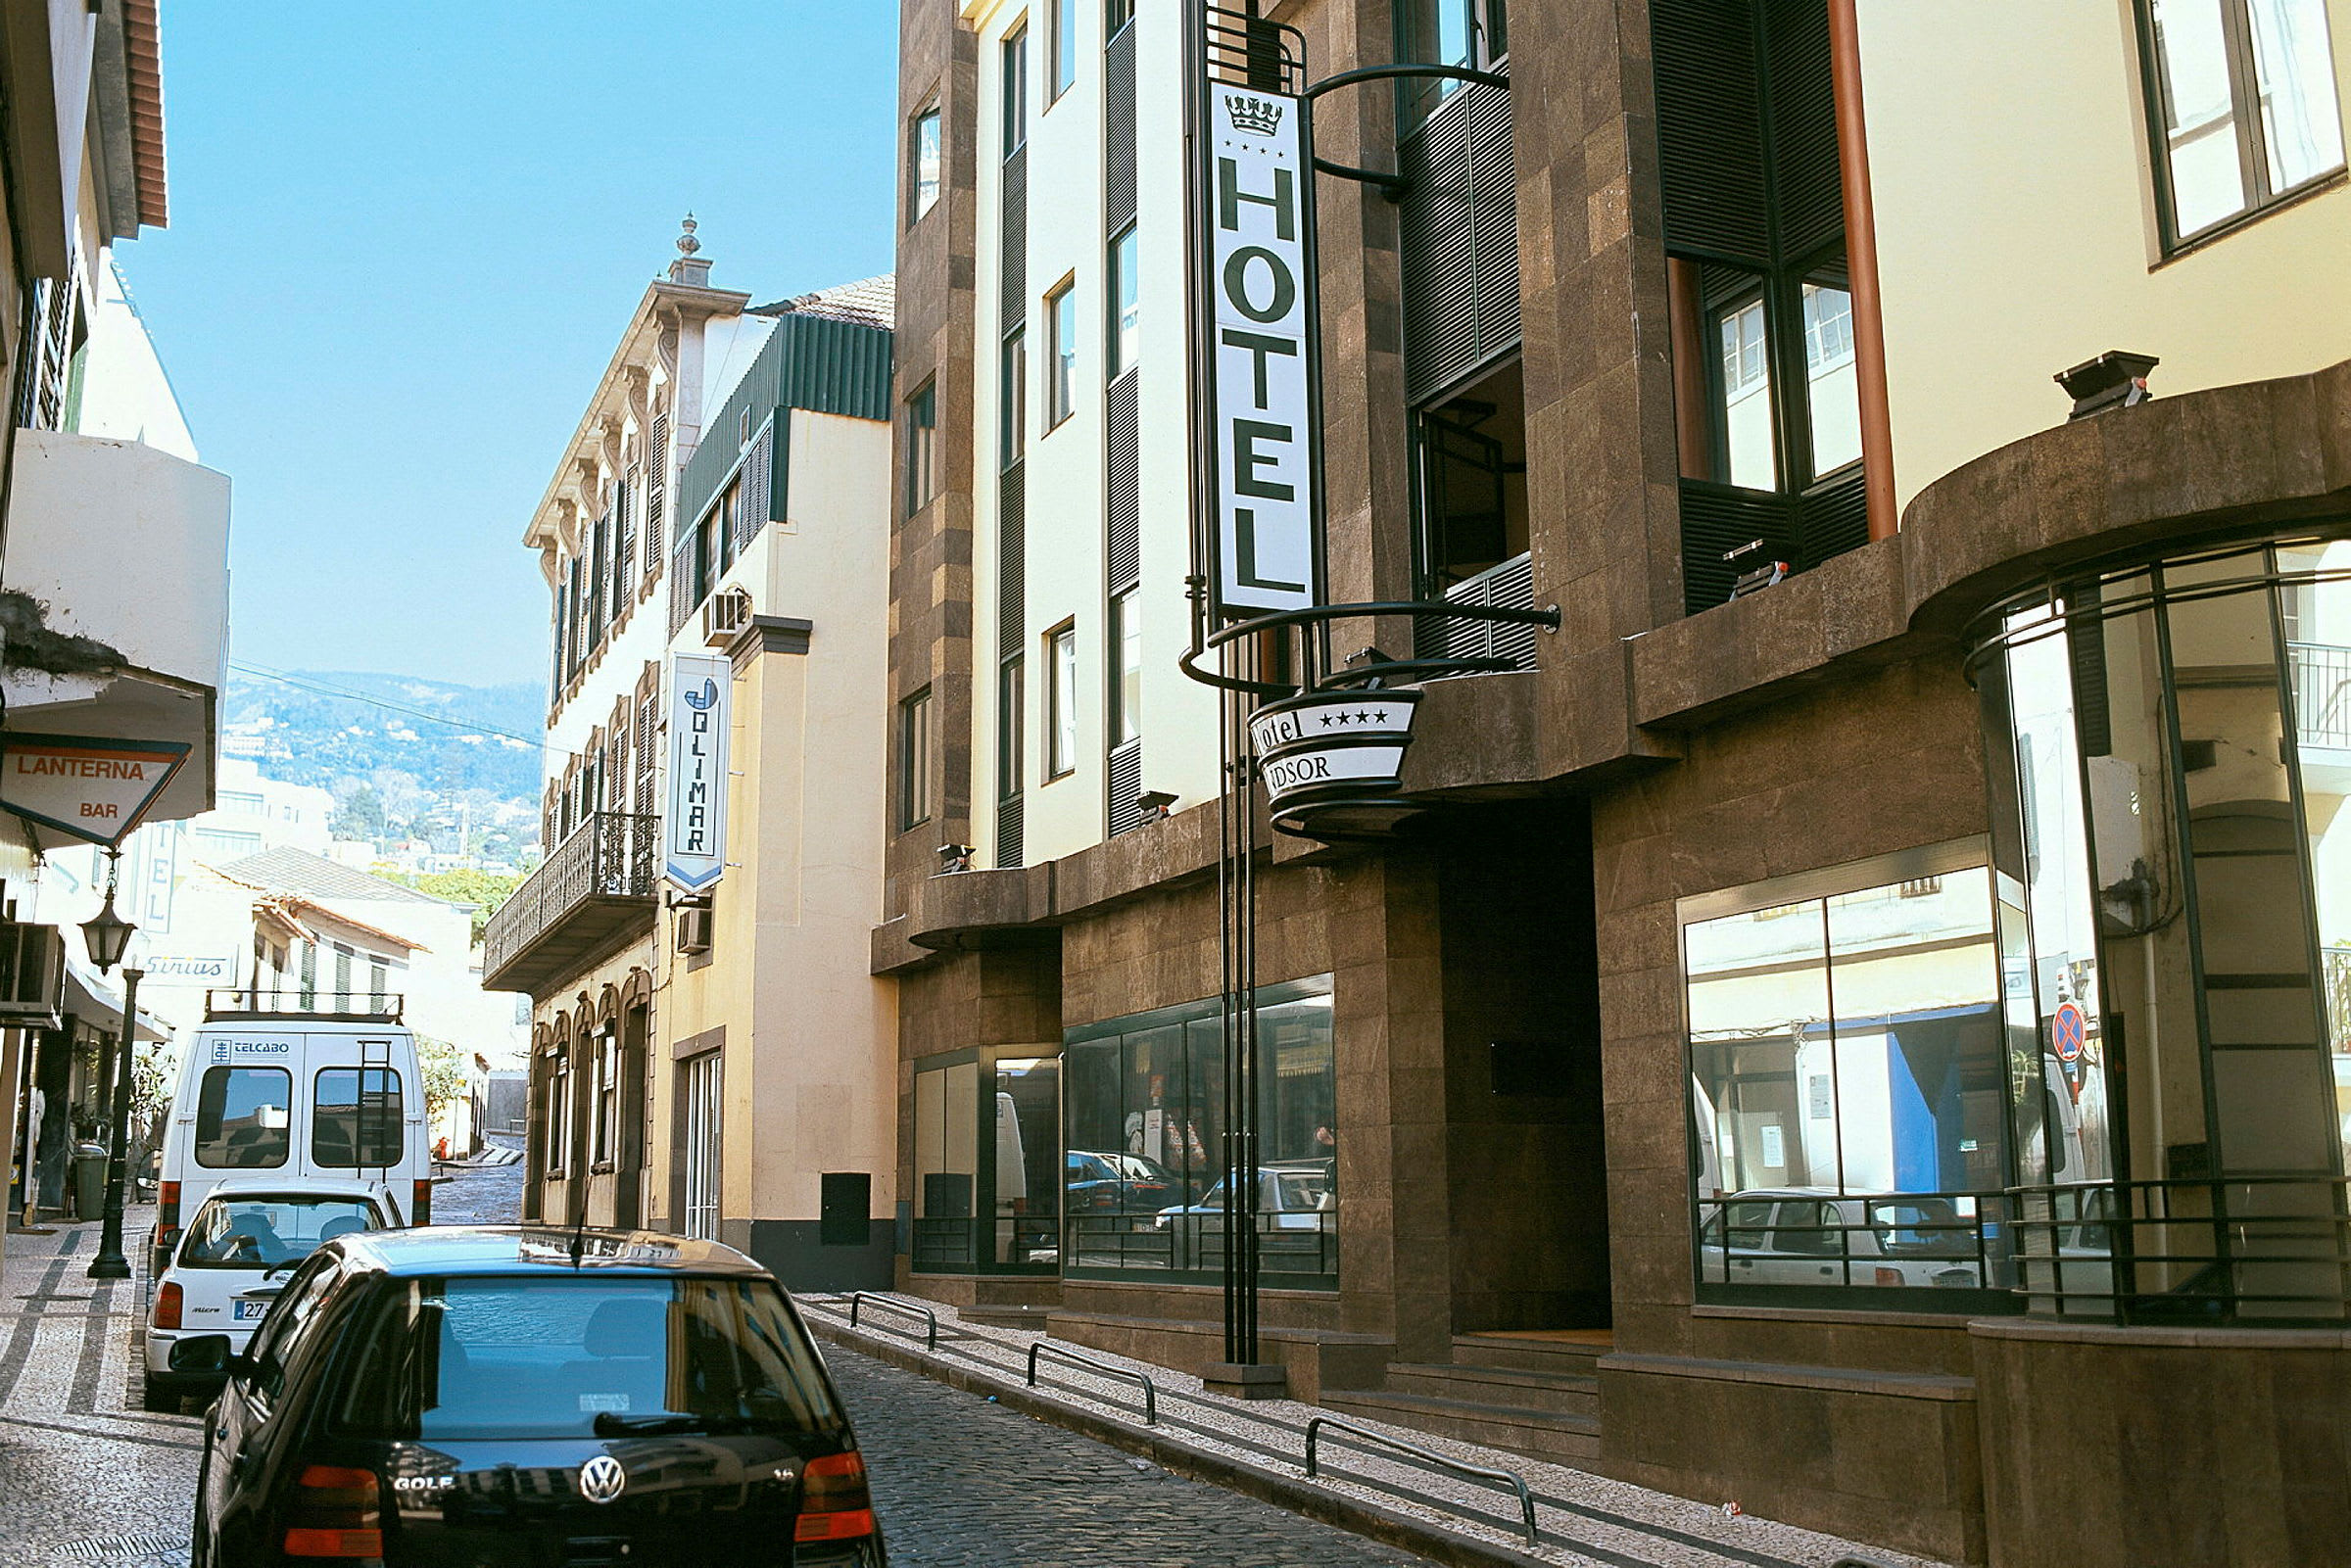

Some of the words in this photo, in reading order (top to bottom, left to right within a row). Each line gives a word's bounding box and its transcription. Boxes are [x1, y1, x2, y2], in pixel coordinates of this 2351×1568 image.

[1218, 157, 1306, 594] HOTEL
[1253, 711, 1304, 749] otel
[18, 756, 144, 781] LANTERNA
[684, 677, 718, 851] JOLIMAR
[79, 802, 118, 819] BAR
[145, 956, 226, 975] Sirius
[235, 1042, 289, 1053] TELCABO
[394, 1476, 455, 1491] GOLF
